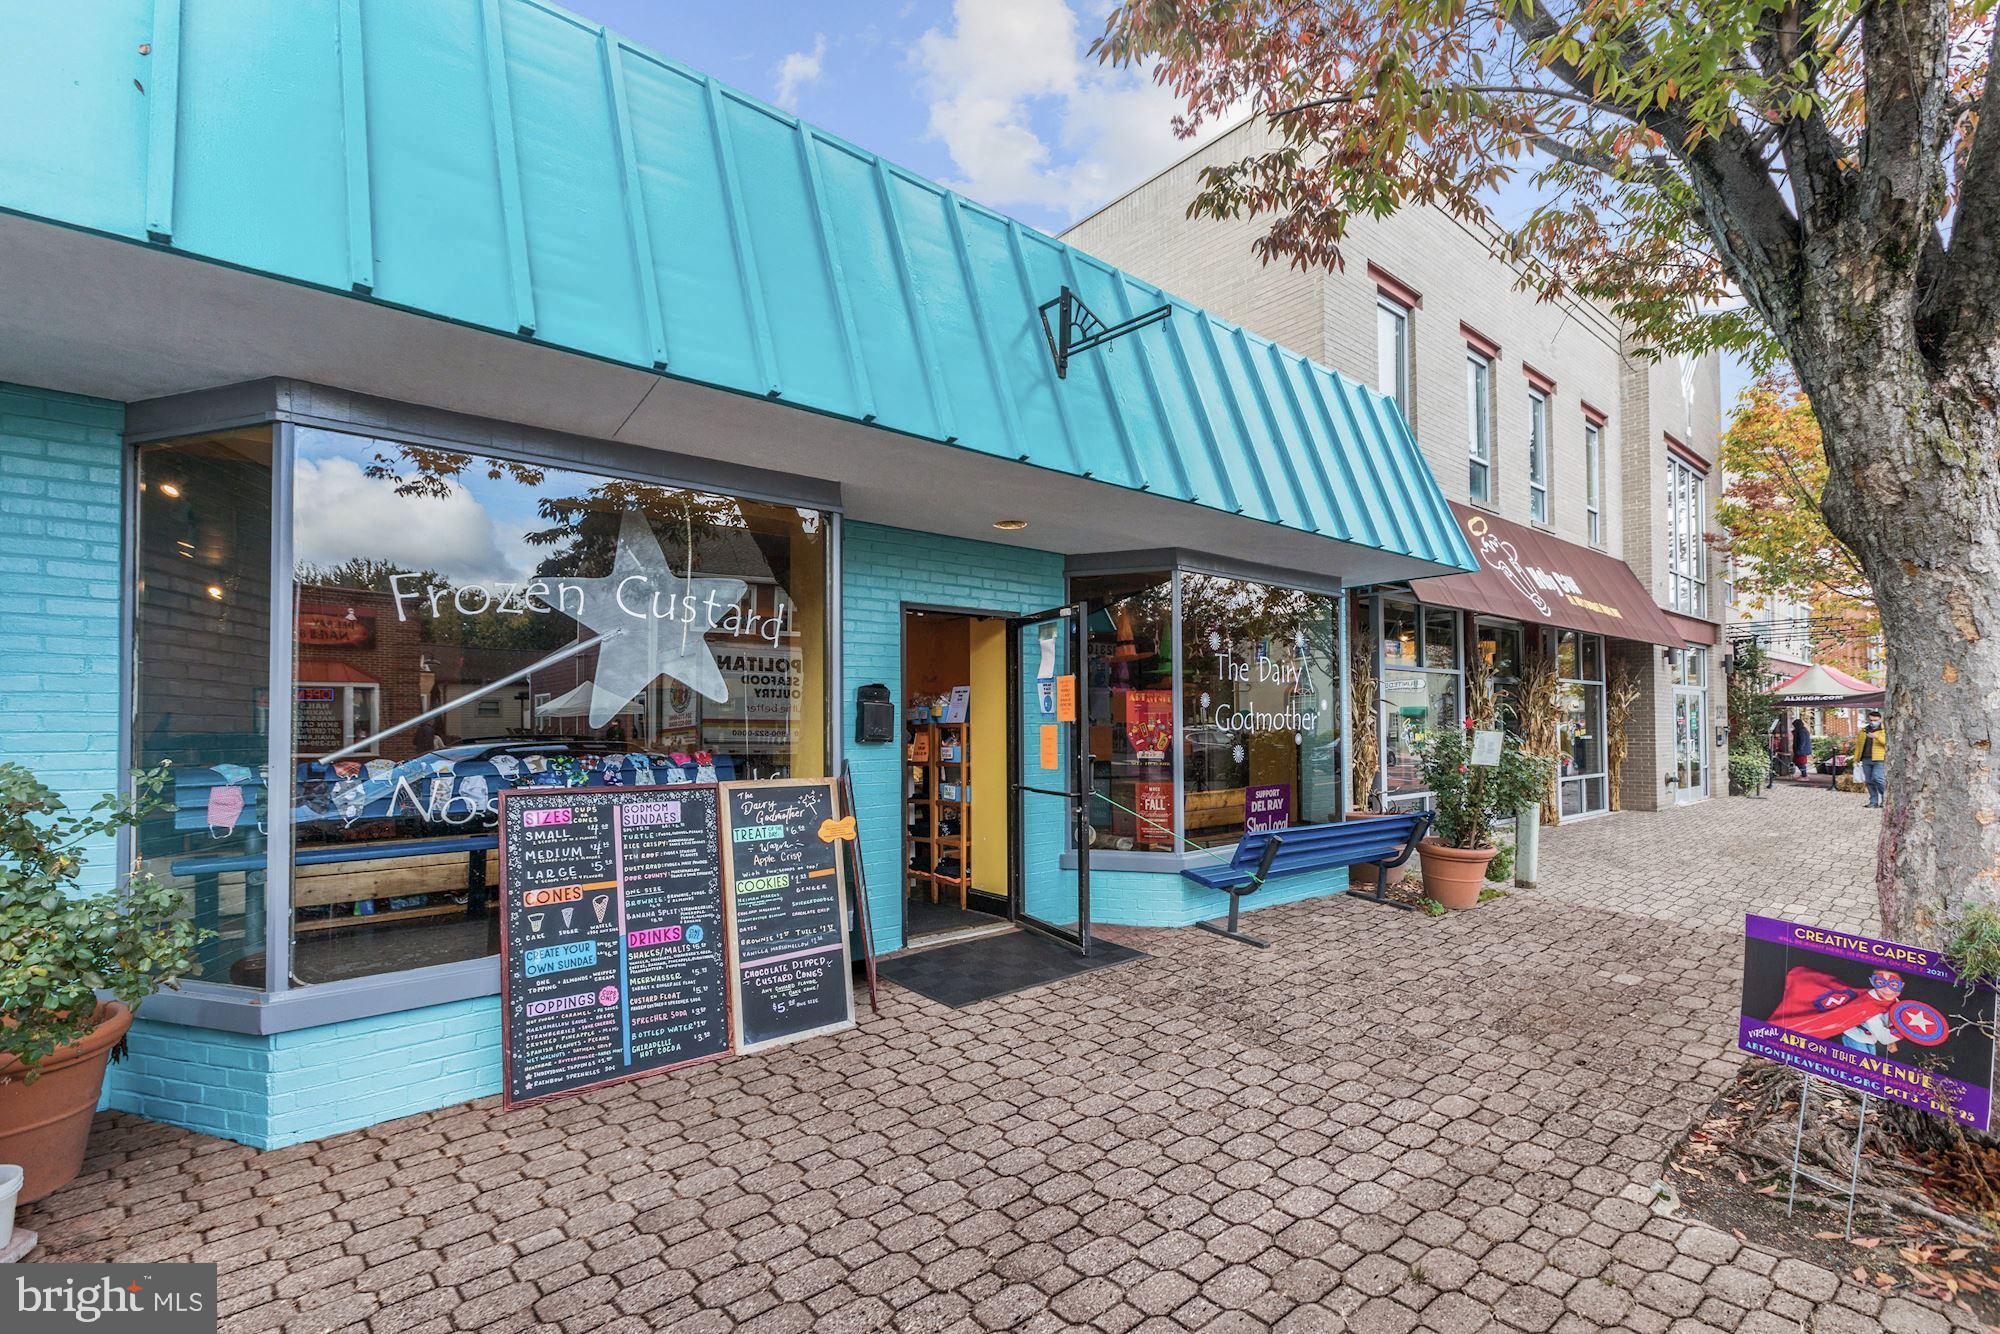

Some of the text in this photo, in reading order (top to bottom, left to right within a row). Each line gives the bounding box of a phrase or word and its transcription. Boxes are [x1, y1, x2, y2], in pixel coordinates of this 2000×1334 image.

[389, 573, 784, 649] Frozen Custard
[1215, 650, 1302, 694] The Dairy
[1215, 700, 1320, 732] Godmother
[1256, 789, 1280, 798] SUPPORT
[624, 803, 668, 814] GODMOM
[741, 800, 778, 815] Dairy
[1145, 799, 1166, 810] FALL
[1251, 798, 1284, 812] DEL RAY
[525, 809, 570, 825] SIZES
[624, 813, 676, 825] SUNDAES
[756, 806, 805, 824] Godmother
[525, 829, 570, 841] SMALL
[735, 828, 767, 840] TREAT
[525, 846, 582, 860] MEDIUM
[760, 841, 794, 852] Warm
[754, 851, 802, 866] Apple Crisp
[527, 866, 577, 880] LARGE
[737, 876, 788, 892] COOKIES
[796, 884, 828, 893] GINGER
[525, 886, 581, 905] CONES
[627, 911, 656, 920] BANANA
[526, 933, 545, 941] CAKE
[630, 927, 680, 946] DRINKS
[741, 935, 774, 946] BROWNIE
[526, 943, 590, 961] CREATE YOUR
[628, 944, 691, 960] SHAKES/MALTS
[742, 942, 809, 957] VANILLA MARSHMELLOW
[1794, 927, 1928, 966] CREATIVE CAPES
[527, 955, 594, 975] OWN SUNDAE
[745, 957, 826, 979] CHOCOLATE DIPPED
[563, 975, 588, 984] ALMONDS
[630, 972, 682, 985] MEERWASSER
[756, 968, 824, 987] CUSTARD CONES
[1926, 968, 1948, 978] 2021!
[528, 984, 557, 994] TOPPING
[528, 994, 594, 1015] TOPPINGS
[630, 995, 658, 1005] CUSTARD
[632, 1010, 688, 1026] SPRECHER SODA
[526, 1022, 570, 1033] MARSHMALLOW
[526, 1028, 576, 1041] STRAWBERRIES
[632, 1024, 693, 1040] BOTTLED WATER
[526, 1031, 595, 1049] CRUSHED PINEAPPLE
[526, 1041, 581, 1057] SPANISH PEANUTS
[541, 1051, 565, 1060] WALNUTS
[640, 1044, 681, 1058] HOT COCOA
[1745, 1041, 1880, 1090] ARTONTHEAVENUE.ORG
[1780, 1032, 1807, 1049] ART
[1808, 1042, 1828, 1055] ON
[1831, 1047, 1857, 1065] THE
[1859, 1057, 1934, 1089] AVENUE
[534, 1060, 596, 1078] INDIVIDUAL TOPPINGS
[534, 1069, 600, 1086] RAINBOW SPRINKLES
[1884, 1085, 1909, 1100] OCT
